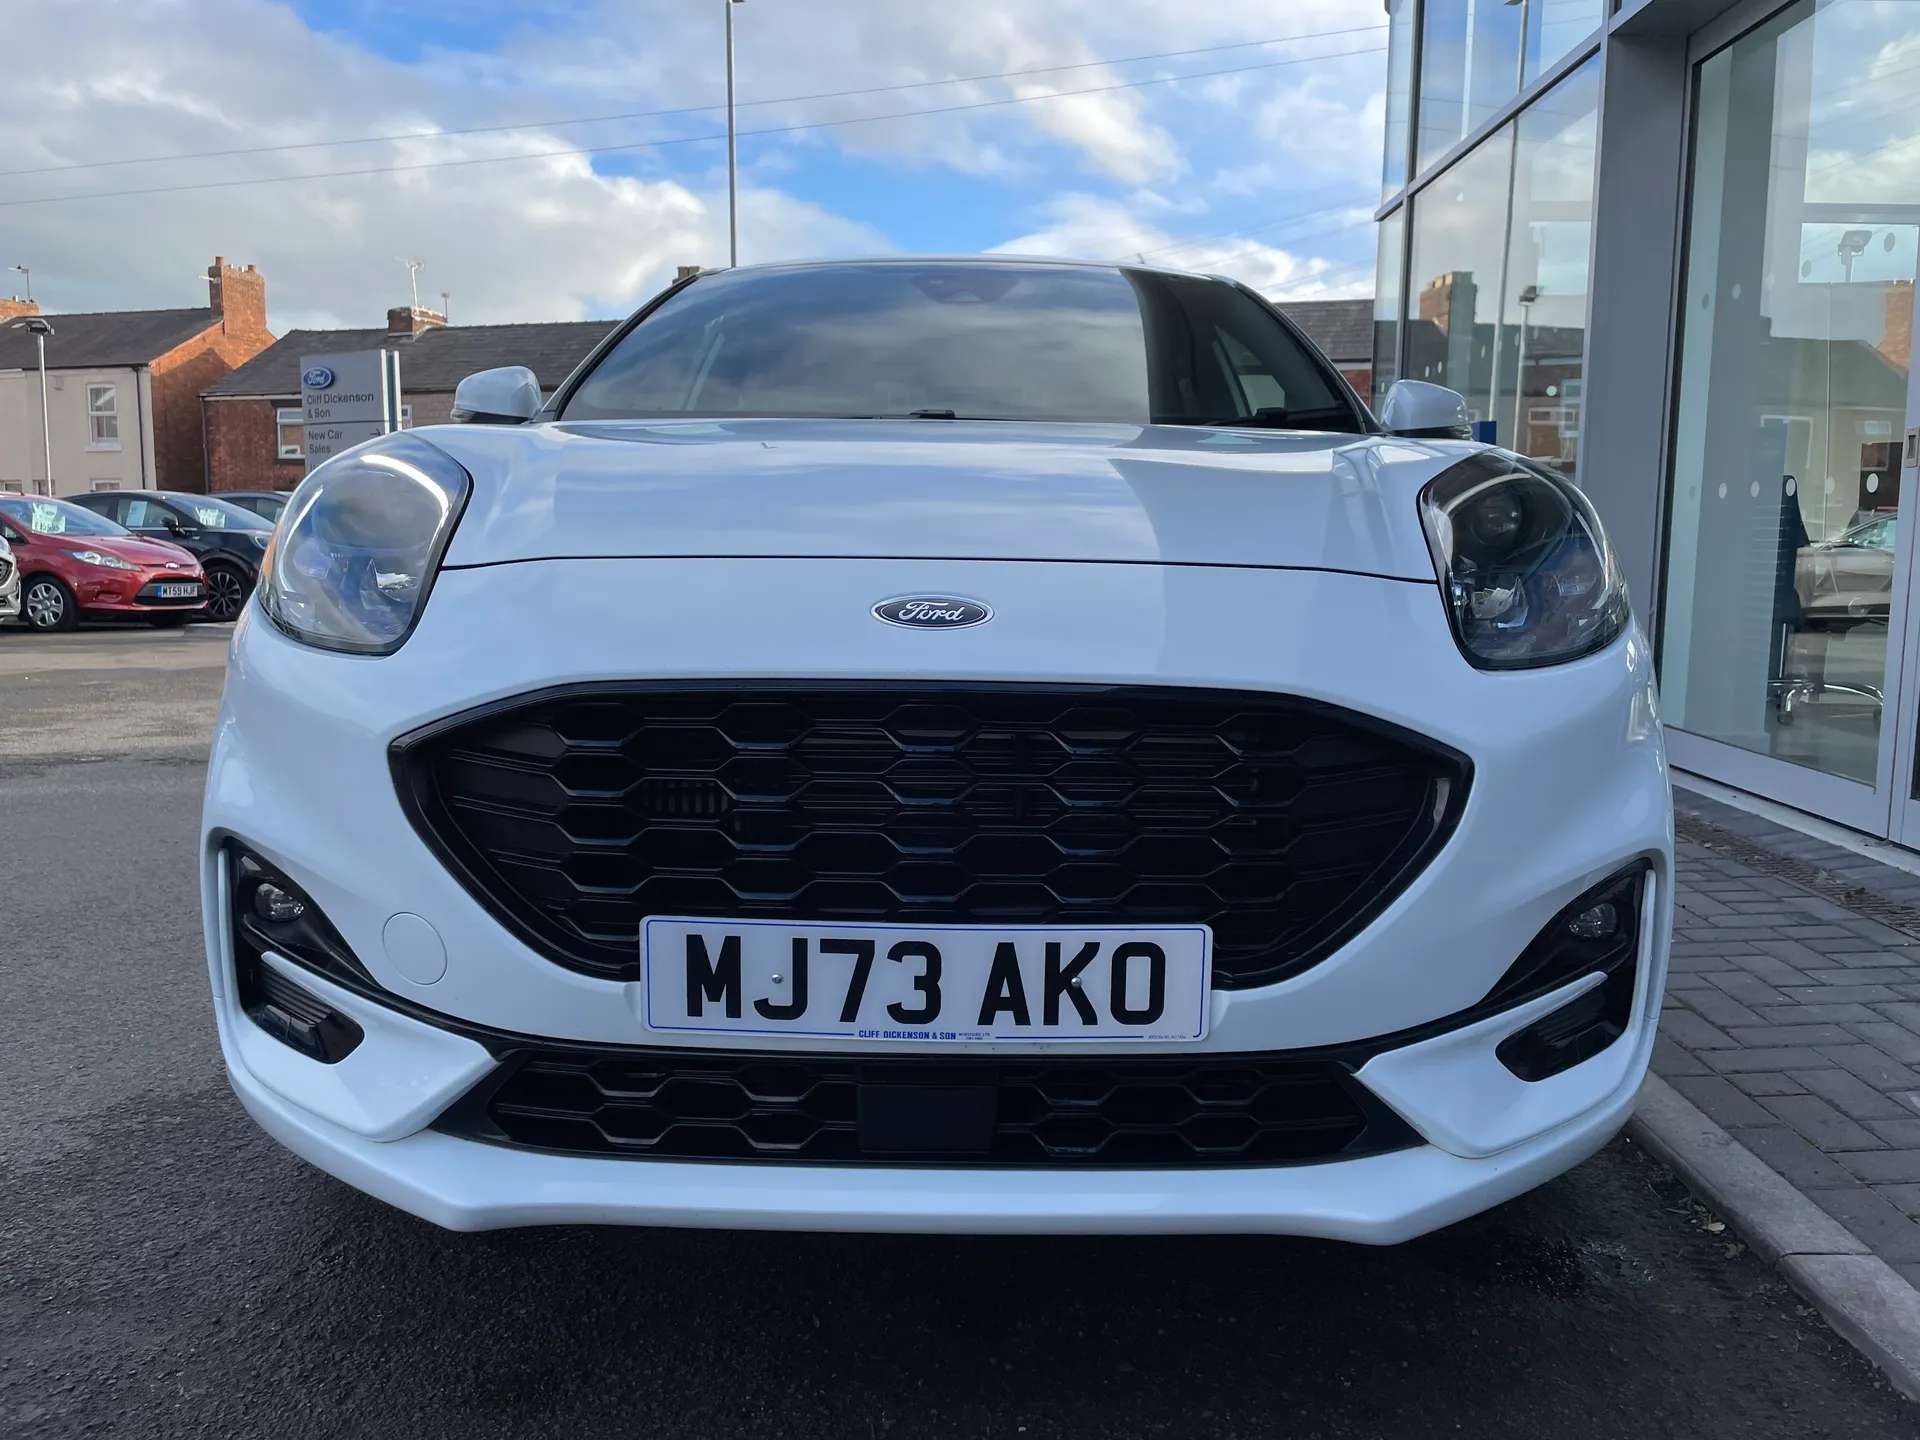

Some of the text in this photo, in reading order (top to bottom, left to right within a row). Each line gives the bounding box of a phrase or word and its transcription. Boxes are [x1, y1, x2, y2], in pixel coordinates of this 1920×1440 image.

[307, 370, 327, 385] Ford
[306, 393, 374, 405] Cliff Dickenson
[307, 408, 331, 419] & Son
[308, 429, 343, 440] New Car
[309, 444, 331, 454] Sales
[898, 601, 965, 621] Ford
[686, 933, 1165, 1027] MJ73 AKO
[858, 1030, 880, 1039] CLIFF
[883, 1030, 930, 1040] DICKENSON
[931, 1032, 937, 1040] &
[939, 1031, 957, 1040] SON
